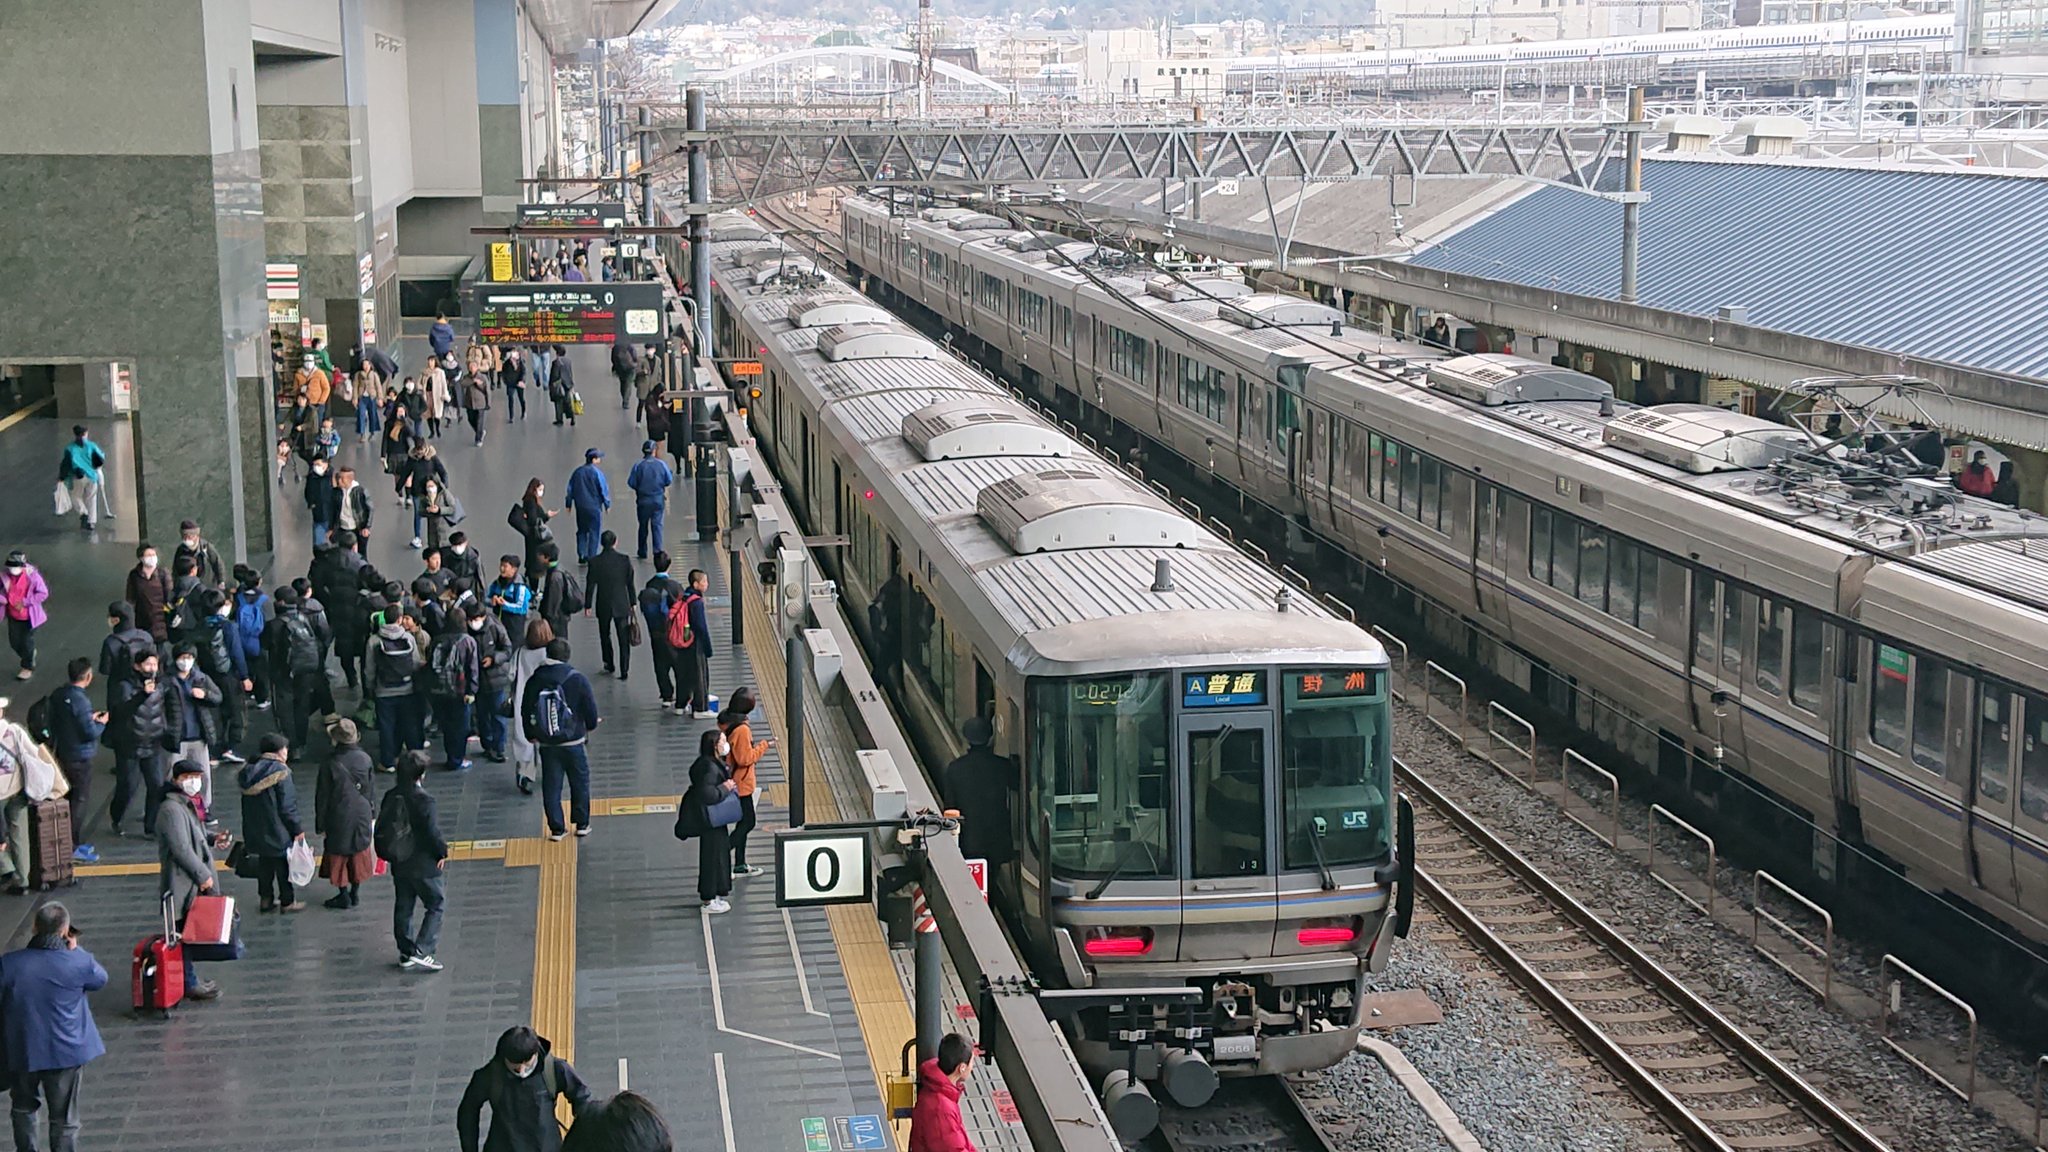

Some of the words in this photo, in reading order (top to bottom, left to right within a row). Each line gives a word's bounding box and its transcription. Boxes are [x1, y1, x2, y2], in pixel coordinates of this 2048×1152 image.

[626, 245, 635, 256] 0
[604, 291, 615, 305] 0
[1190, 679, 1203, 693] A
[1207, 672, 1256, 694] 普通
[1343, 810, 1368, 825] JR
[806, 846, 840, 893] 0
